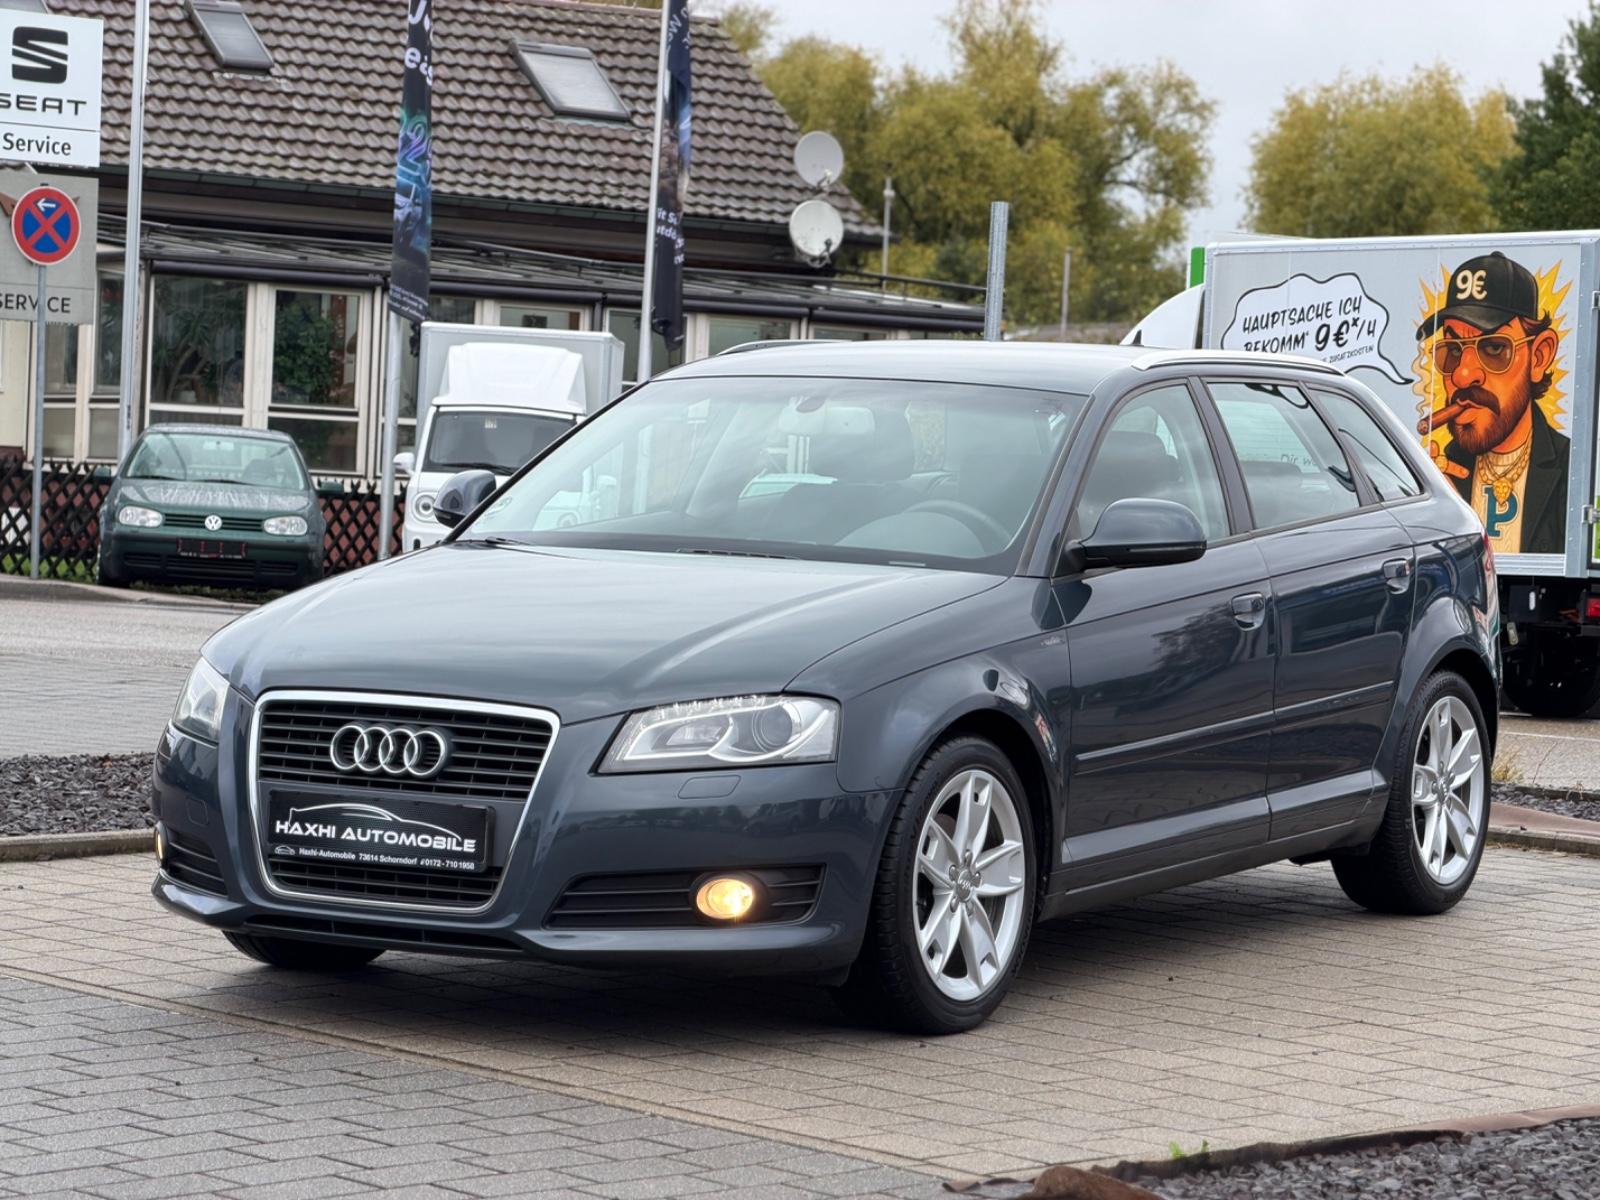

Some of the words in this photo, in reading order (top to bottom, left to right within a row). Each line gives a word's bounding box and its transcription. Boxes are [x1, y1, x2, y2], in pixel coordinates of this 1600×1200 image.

[0, 93, 87, 116] SEAT
[3, 132, 71, 156] Service
[1456, 269, 1488, 300] 9€
[0, 292, 72, 313] ERVCE
[1243, 301, 1333, 334] HAUPTSACHE
[1339, 295, 1362, 317] ICH
[275, 820, 336, 839] HAXHI
[341, 827, 477, 853] AUTOMOBILE
[299, 848, 356, 861] Haxhi-Automobile
[380, 855, 418, 866] Schorndorf
